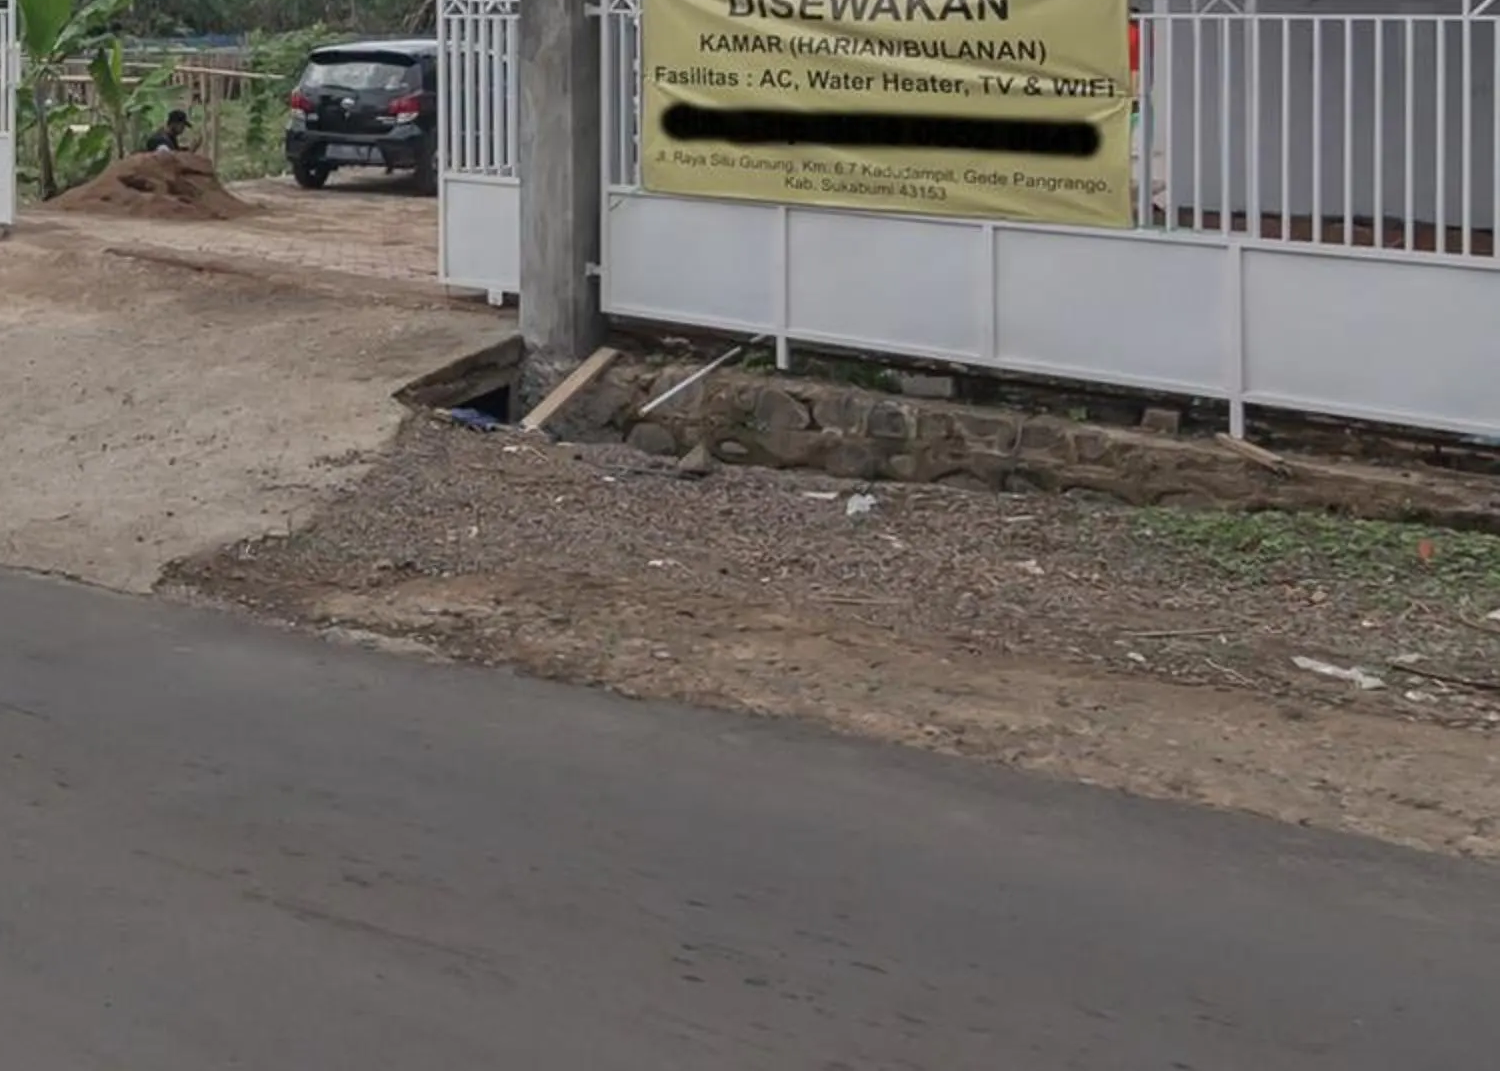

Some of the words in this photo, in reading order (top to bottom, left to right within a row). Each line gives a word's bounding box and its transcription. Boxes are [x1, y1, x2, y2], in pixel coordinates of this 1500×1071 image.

[700, 33, 782, 53] KAMAR
[655, 65, 740, 87] Fasilitas
[759, 69, 800, 91] AC,
[807, 70, 873, 91] Water
[882, 73, 970, 97] Heater,
[979, 75, 1013, 95] TV
[1023, 76, 1042, 96] &
[674, 150, 707, 168] Raya
[964, 168, 1009, 187] Gede
[784, 176, 818, 192] Kab.
[821, 177, 895, 196] Sukabumi
[899, 183, 948, 201] 43153
